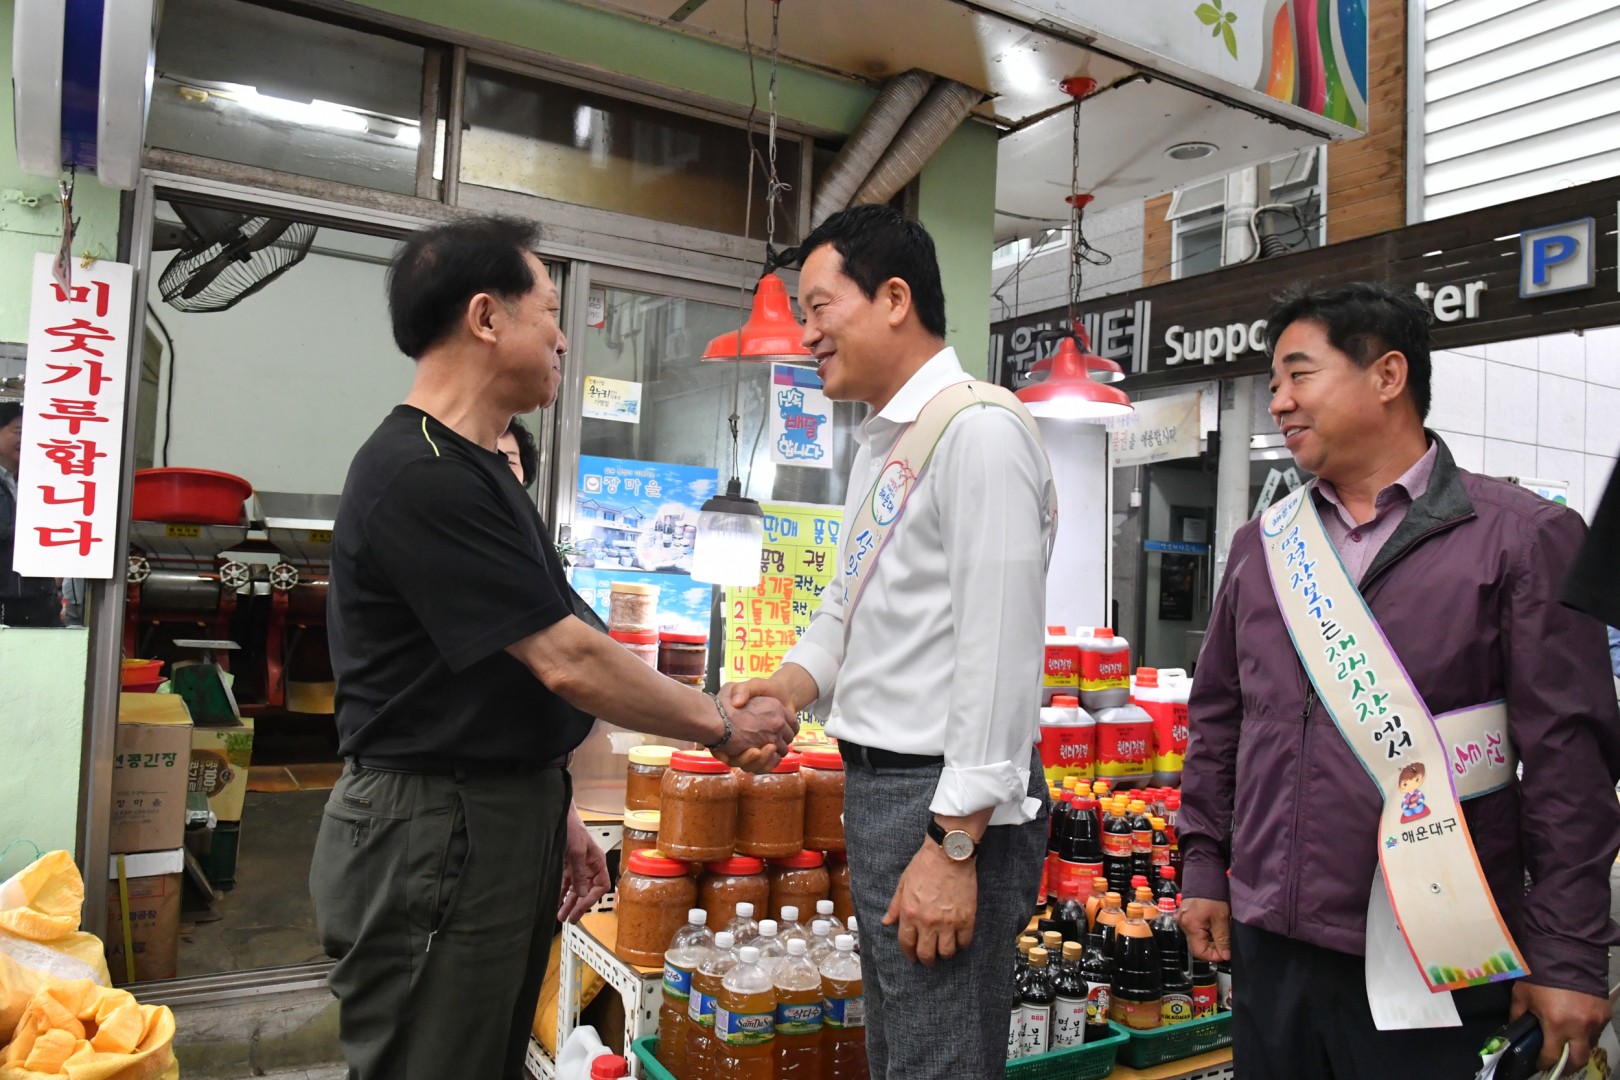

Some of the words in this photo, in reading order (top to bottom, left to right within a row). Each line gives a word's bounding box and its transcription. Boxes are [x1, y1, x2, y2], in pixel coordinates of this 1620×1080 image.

[1531, 235, 1580, 286] P
[1165, 318, 1270, 366] Suppo
[1415, 280, 1486, 322] ter
[588, 385, 611, 400] 온누리
[34, 280, 116, 556] 미숫가루합니다
[786, 415, 818, 440] 배달
[779, 433, 823, 458] 합니다
[802, 549, 826, 573] 구분
[733, 600, 745, 620] 2
[735, 626, 748, 651] 3
[733, 655, 745, 675] 4
[1401, 817, 1457, 844] 해운대구
